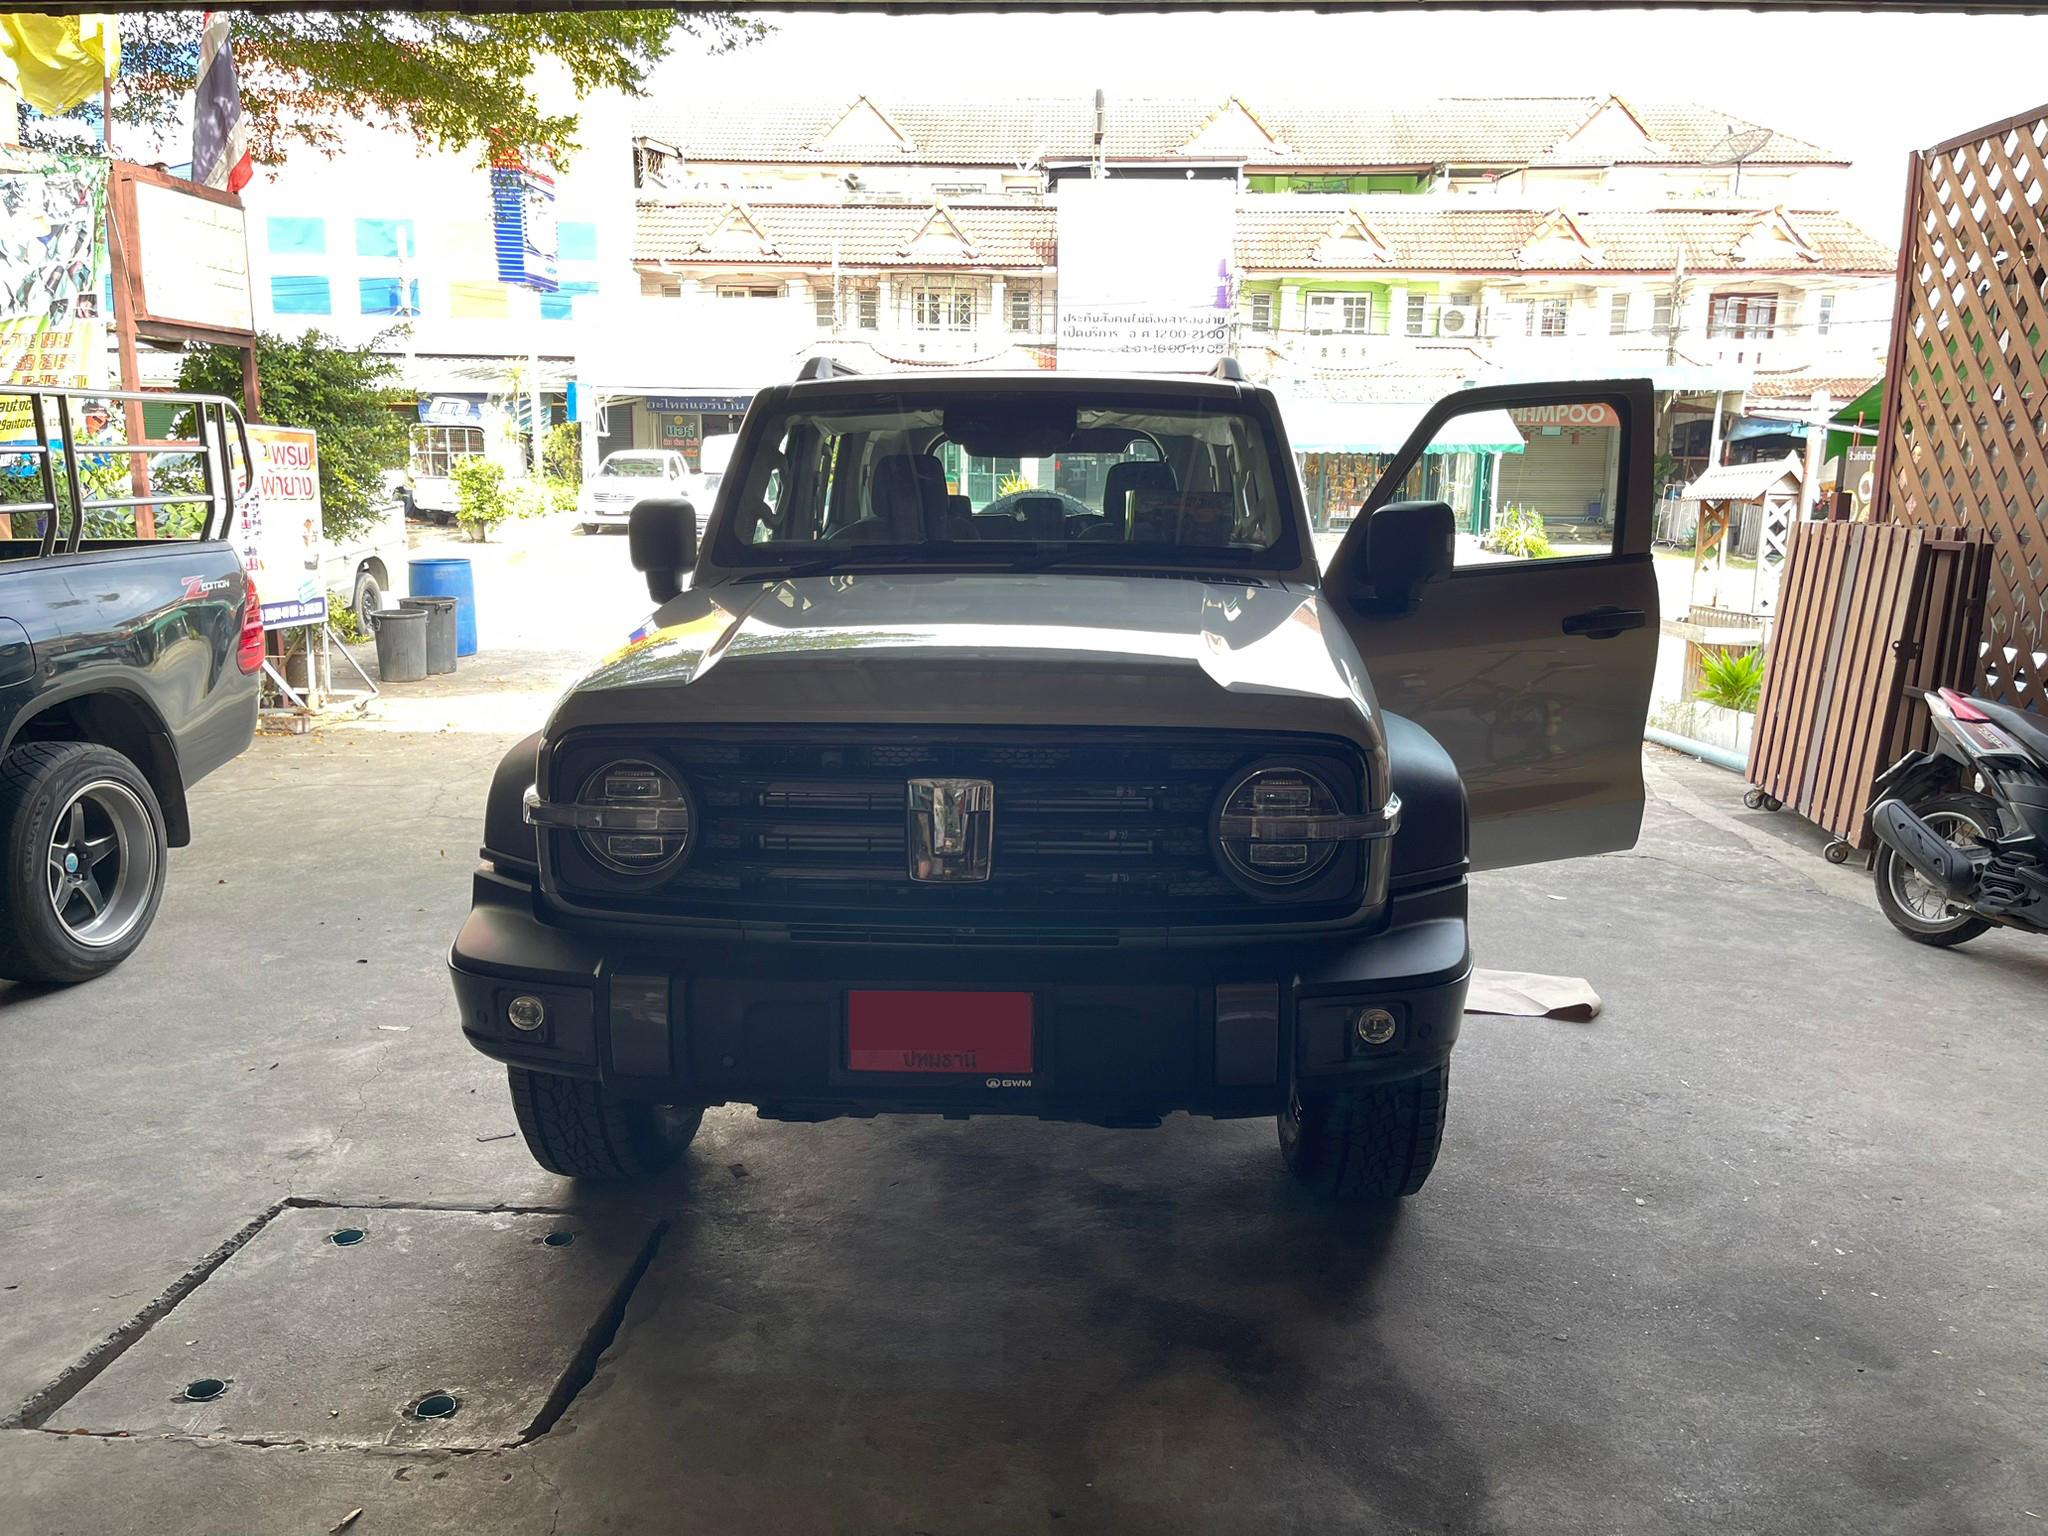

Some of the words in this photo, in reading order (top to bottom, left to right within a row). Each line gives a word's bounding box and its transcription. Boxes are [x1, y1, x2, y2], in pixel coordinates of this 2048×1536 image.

[667, 422, 696, 438] แอร์
[271, 445, 309, 466] พรม
[201, 579, 230, 591] EDITION
[903, 1049, 977, 1071] ปทุมธานี
[1001, 1078, 1032, 1088] GWM
